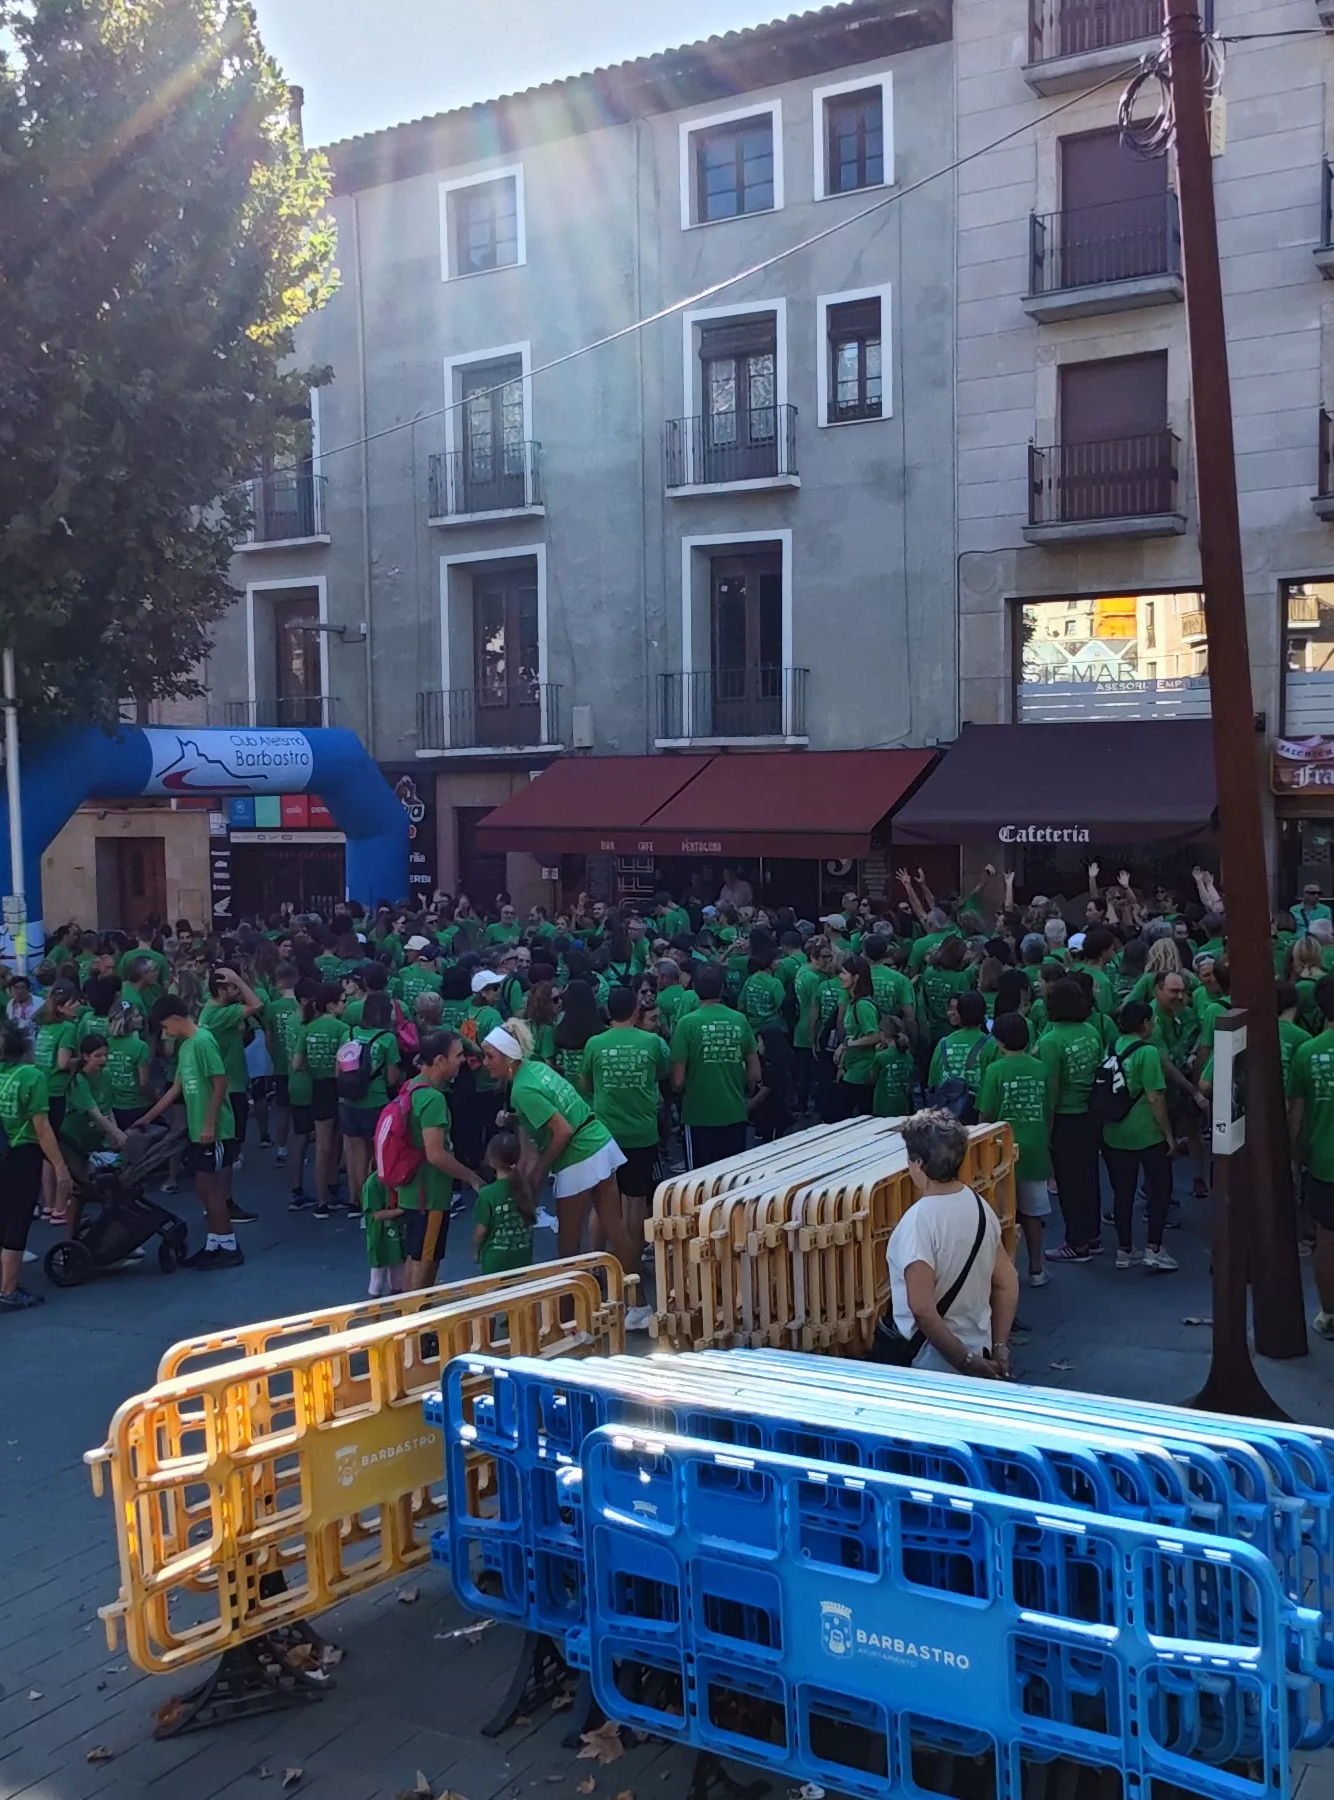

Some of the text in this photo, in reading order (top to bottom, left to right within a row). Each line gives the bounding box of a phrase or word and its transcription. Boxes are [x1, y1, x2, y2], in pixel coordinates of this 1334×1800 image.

[235, 750, 309, 766] Barbastro
[998, 825, 1090, 842] Cafetería
[361, 1434, 436, 1467] BARBASTRO
[856, 1629, 970, 1669] BARBASTRO
